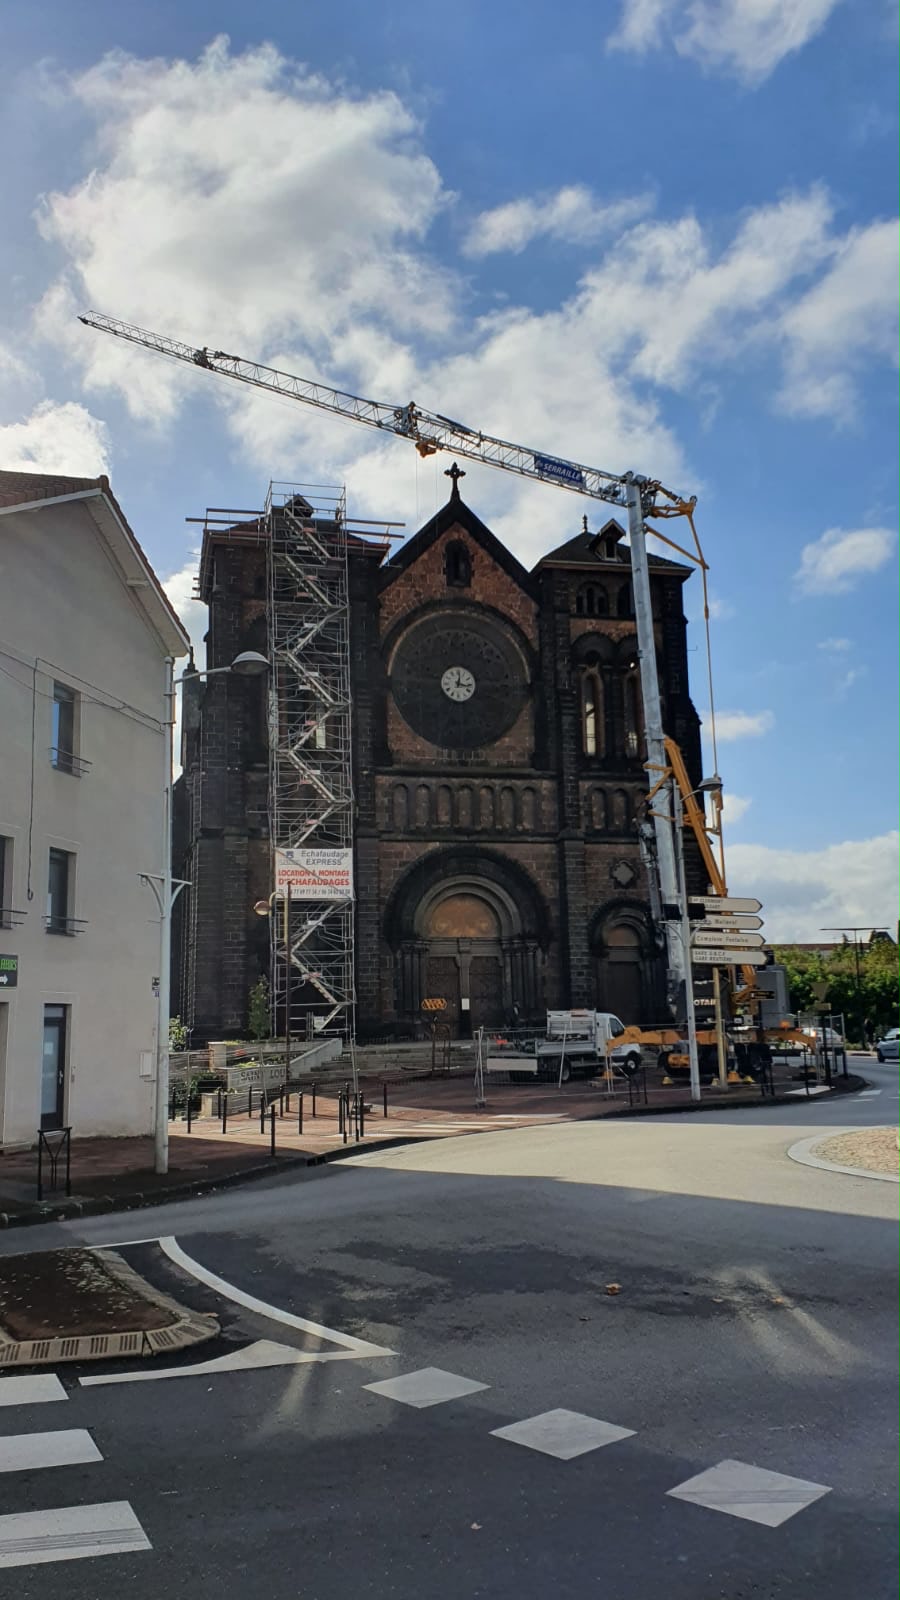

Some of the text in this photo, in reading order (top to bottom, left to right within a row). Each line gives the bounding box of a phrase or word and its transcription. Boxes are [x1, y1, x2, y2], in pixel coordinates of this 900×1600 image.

[306, 858, 342, 866] EXPRESS
[278, 869, 310, 877] LOCATION
[318, 869, 350, 877] MONTAGE
